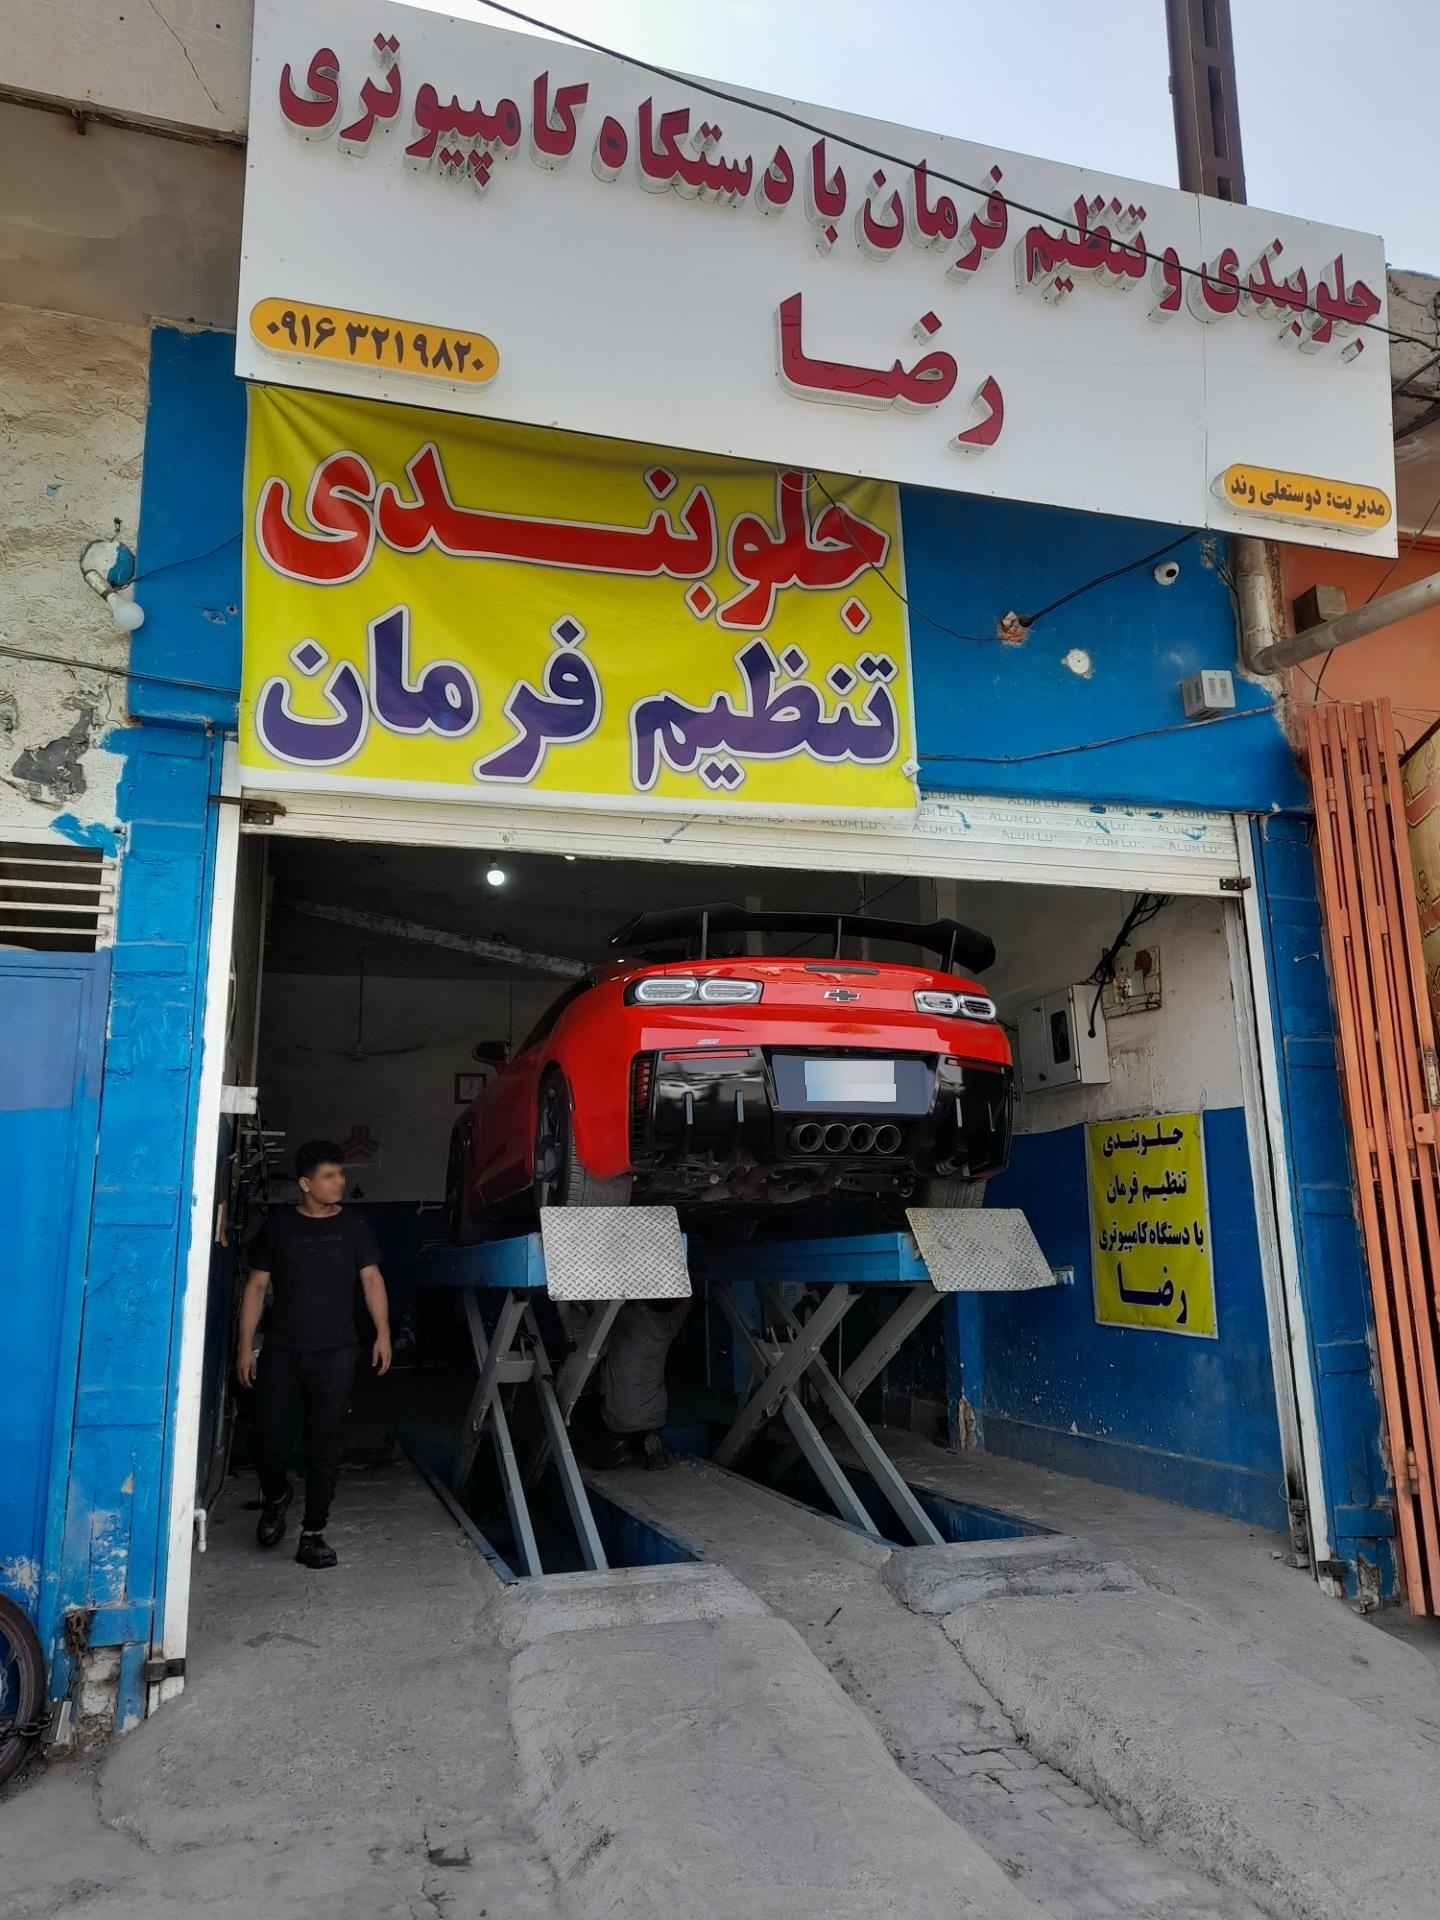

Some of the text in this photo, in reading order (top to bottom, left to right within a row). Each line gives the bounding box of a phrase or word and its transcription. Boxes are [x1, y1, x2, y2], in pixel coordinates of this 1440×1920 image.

[280, 32, 590, 188] کامپیوتری
[863, 160, 1009, 270] فرمان
[1025, 194, 1147, 293] تنظیم
[779, 293, 1004, 445] رضا
[257, 442, 890, 632] جلوبندی
[1326, 491, 1385, 519] مدیریت:
[257, 604, 899, 792] تنظیم فرمان
[1103, 1122, 1184, 1158] جلوبندی
[1107, 1170, 1187, 1205] تنظیم فرمان
[1149, 1221, 1190, 1246] دستگاه
[1193, 1220, 1205, 1253] با
[1116, 1261, 1187, 1325] رضا
